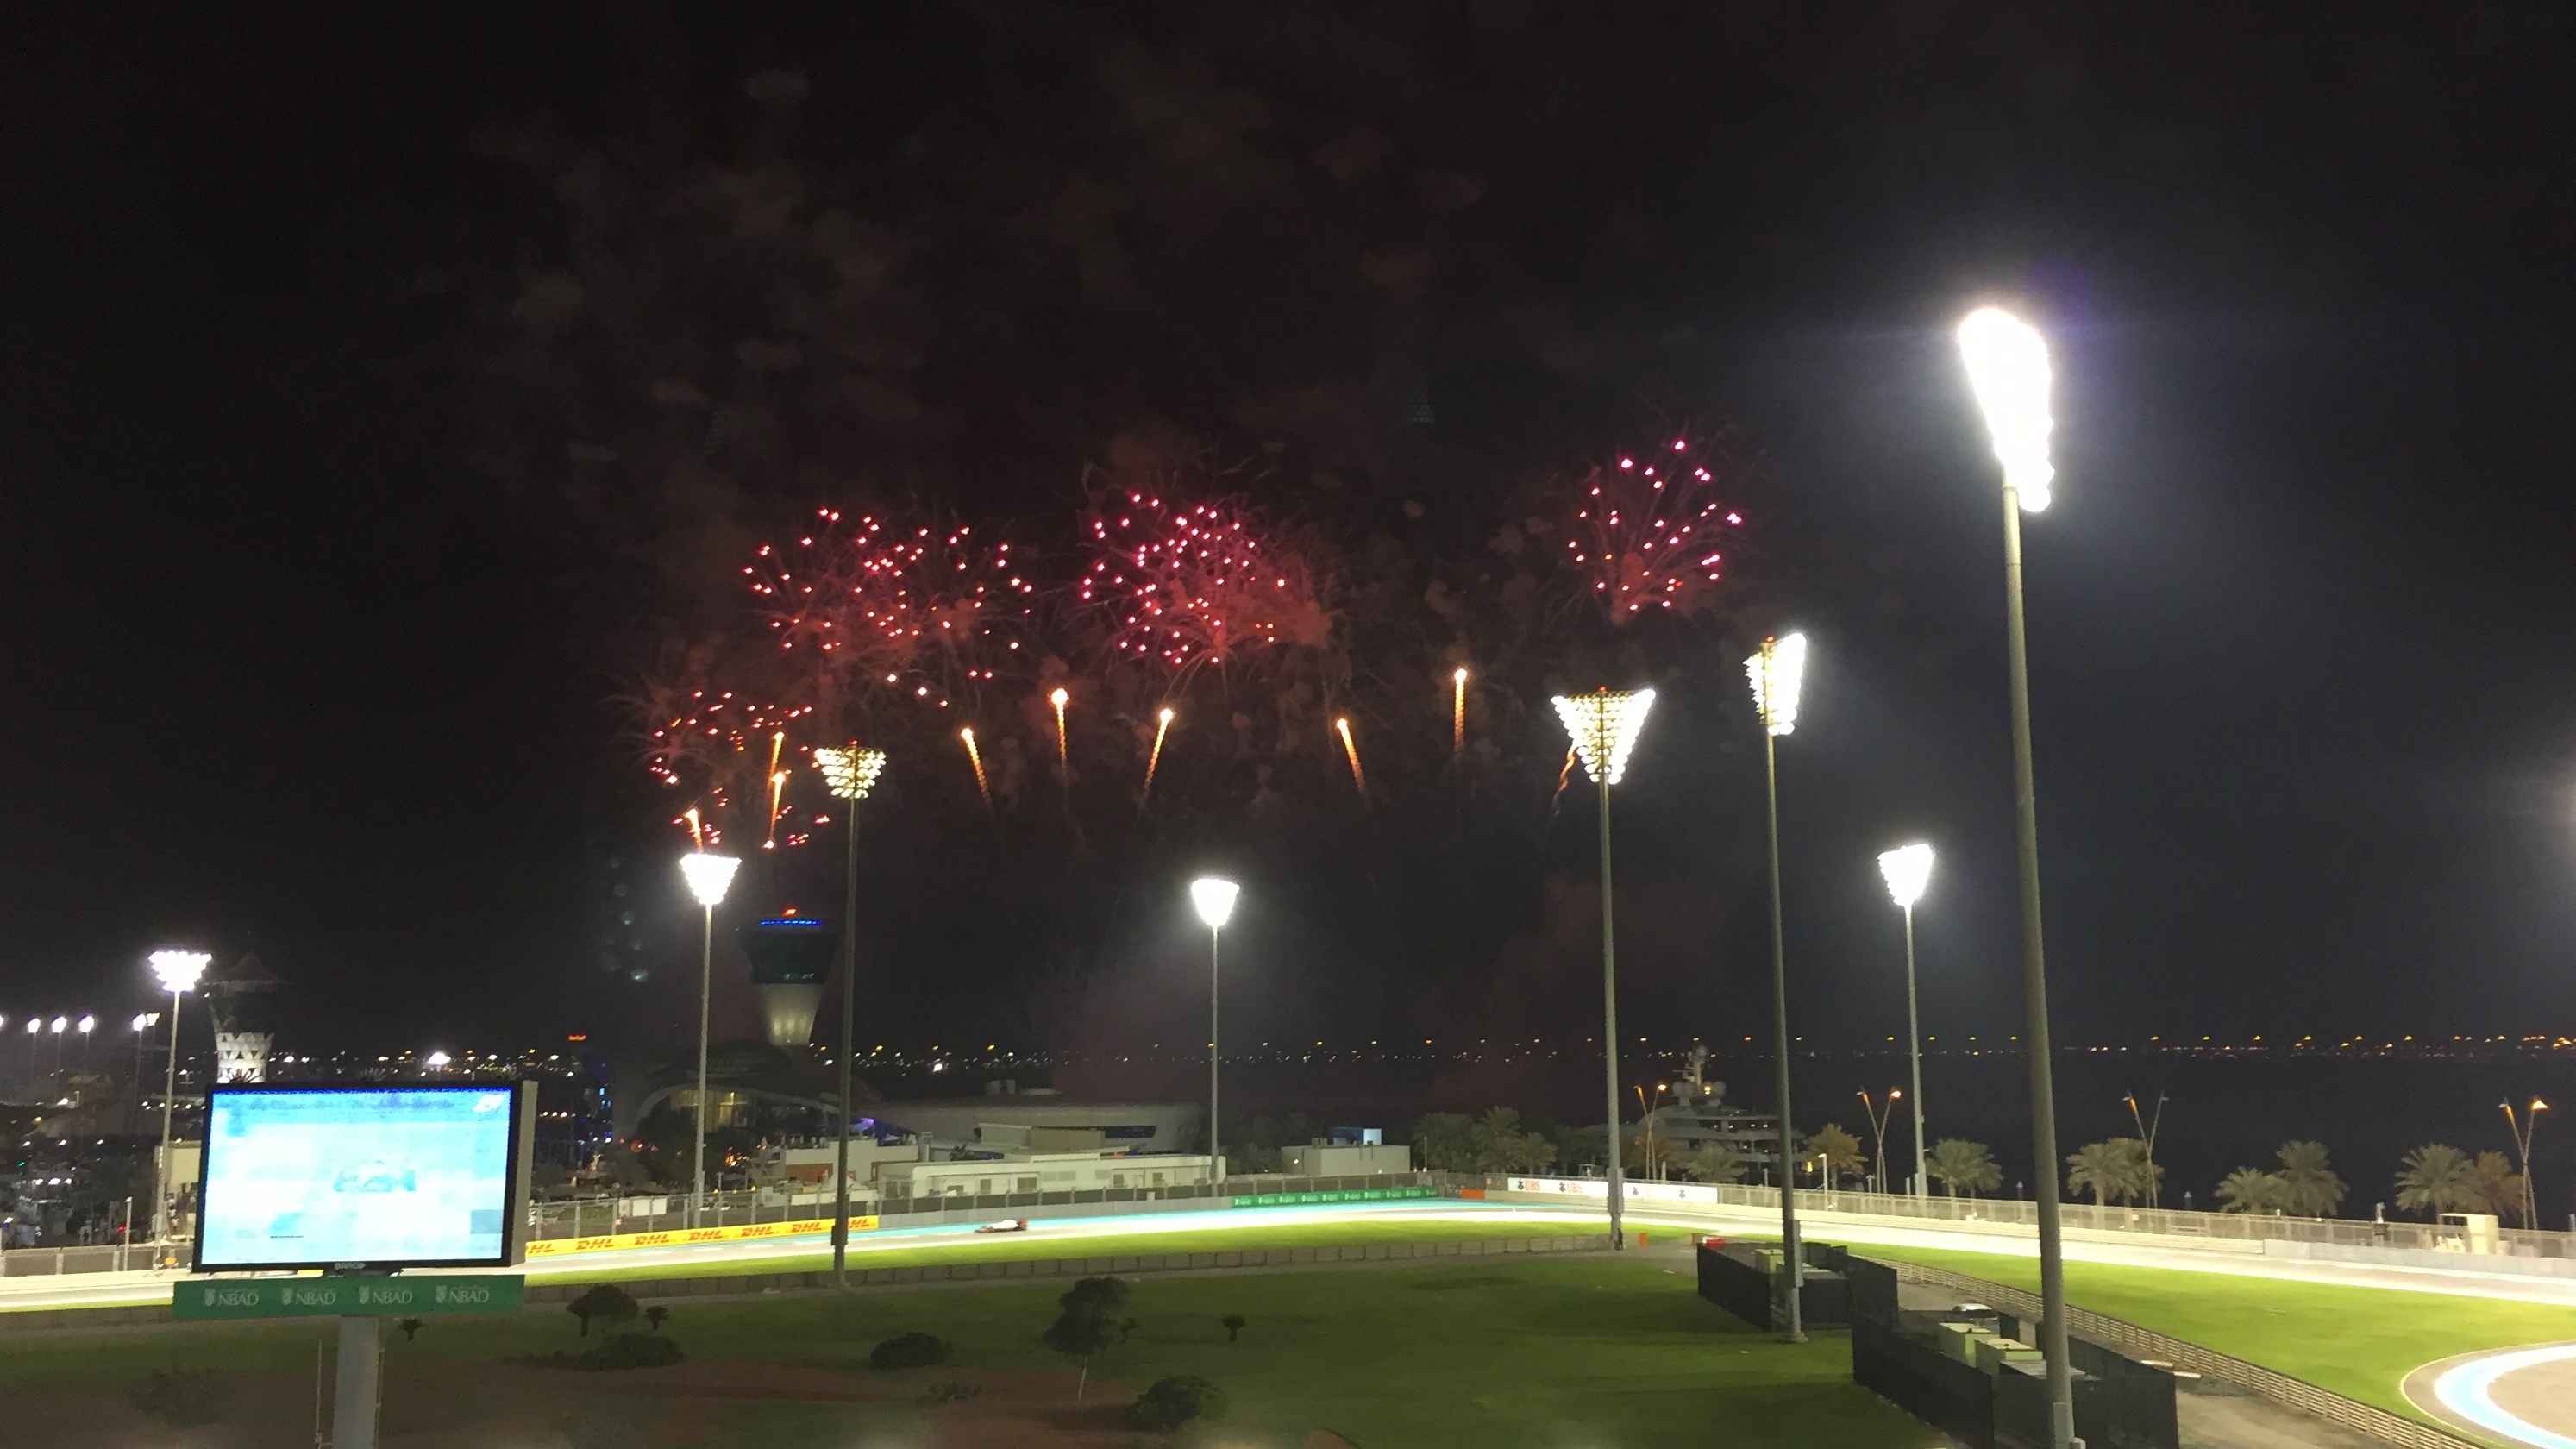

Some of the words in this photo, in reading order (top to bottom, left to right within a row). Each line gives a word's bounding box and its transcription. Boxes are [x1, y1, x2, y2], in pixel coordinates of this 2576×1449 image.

[525, 1243, 555, 1254] HL
[576, 1239, 615, 1251] DHL
[634, 1233, 670, 1245] DHL
[689, 1230, 724, 1241] DHL
[741, 1226, 774, 1237] DHL
[791, 1221, 823, 1233] DHL
[217, 1290, 259, 1307] NBAD
[296, 1289, 336, 1305] NBAD
[372, 1289, 413, 1304] NBAD
[449, 1288, 490, 1303] NBAD
